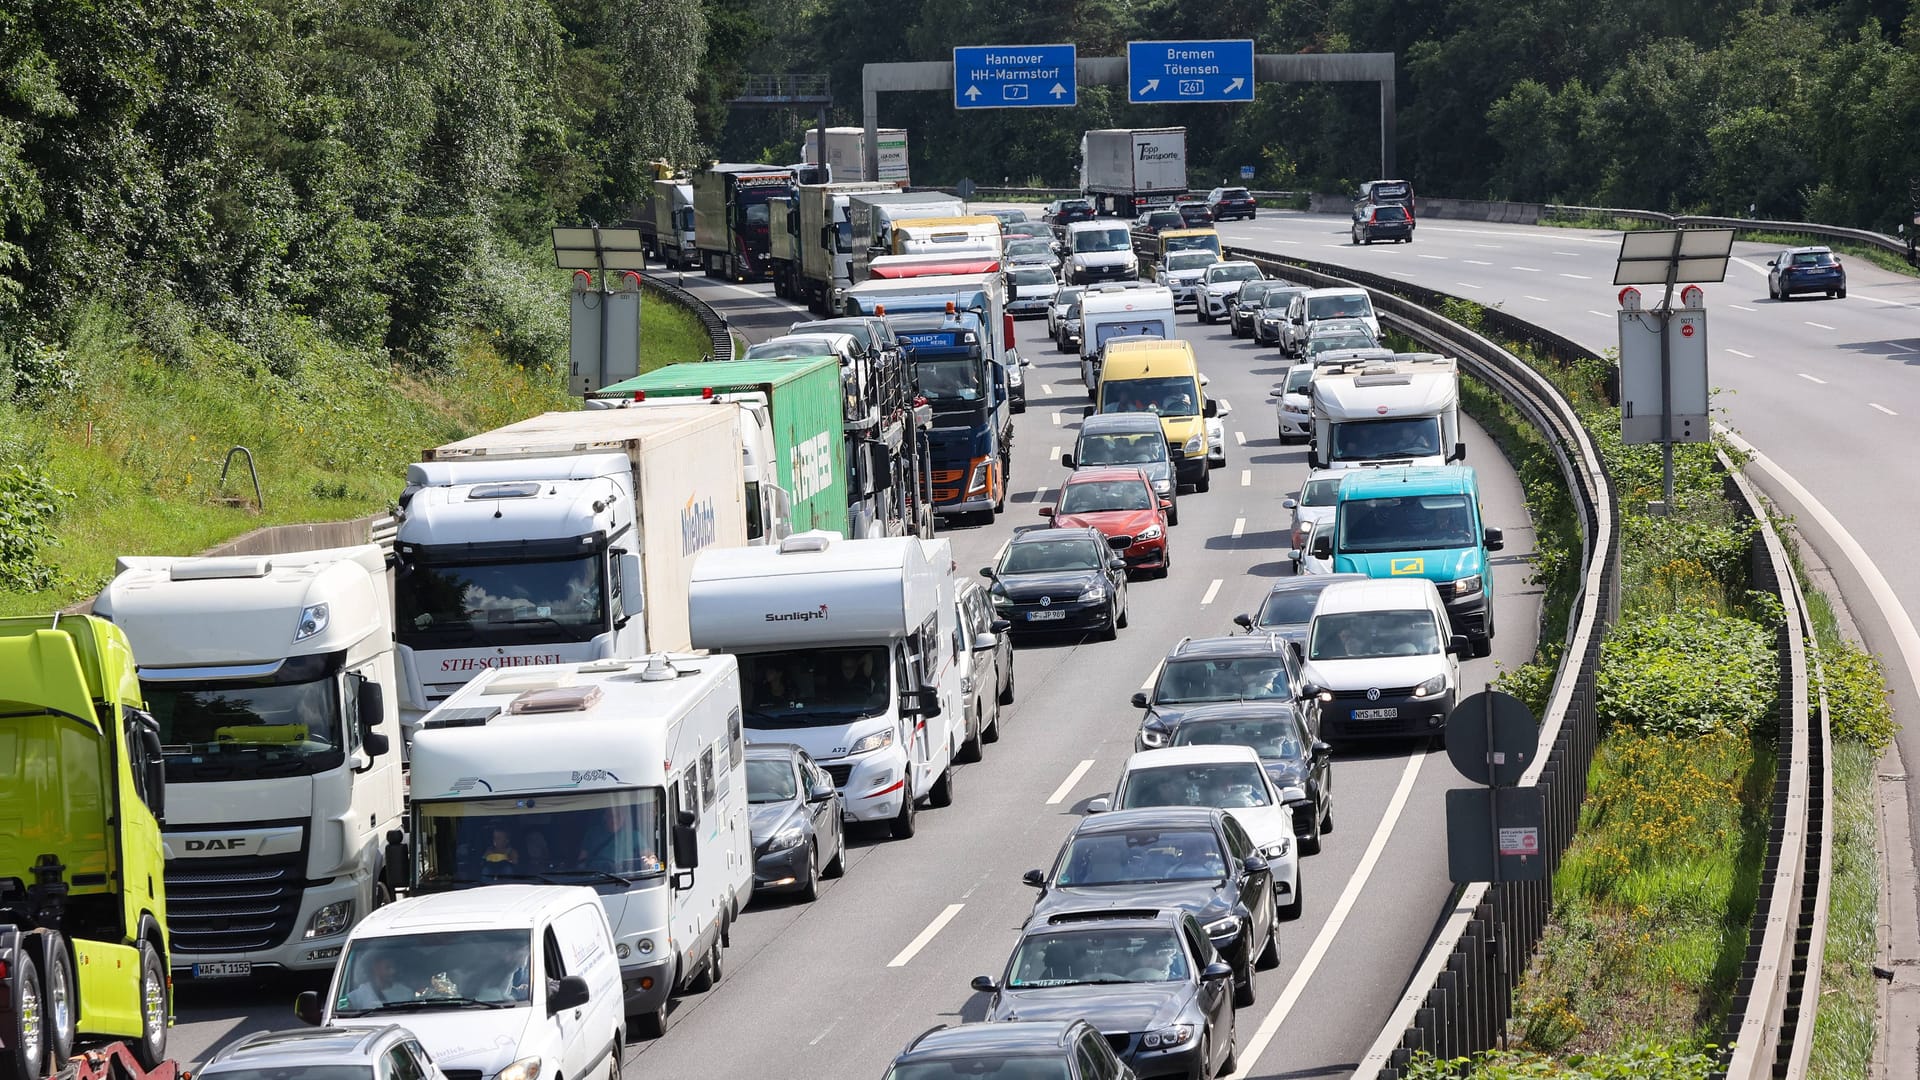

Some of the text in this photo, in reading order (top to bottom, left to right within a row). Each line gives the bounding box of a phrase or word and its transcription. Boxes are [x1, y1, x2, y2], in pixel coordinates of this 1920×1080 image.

[985, 53, 1044, 66] Hannover
[1167, 48, 1215, 60] Bremen
[971, 67, 1059, 81] HH-Marmstorf
[1164, 63, 1219, 76] Tötensen
[1012, 87, 1019, 97] 7
[1183, 82, 1200, 93] 261
[1137, 142, 1159, 157] Topp
[765, 608, 825, 622] Sunlight
[1355, 710, 1369, 719] NMS
[1373, 710, 1382, 718] ML
[184, 838, 246, 851] DAF
[199, 964, 215, 975] WAF
[228, 963, 250, 974] 1155
